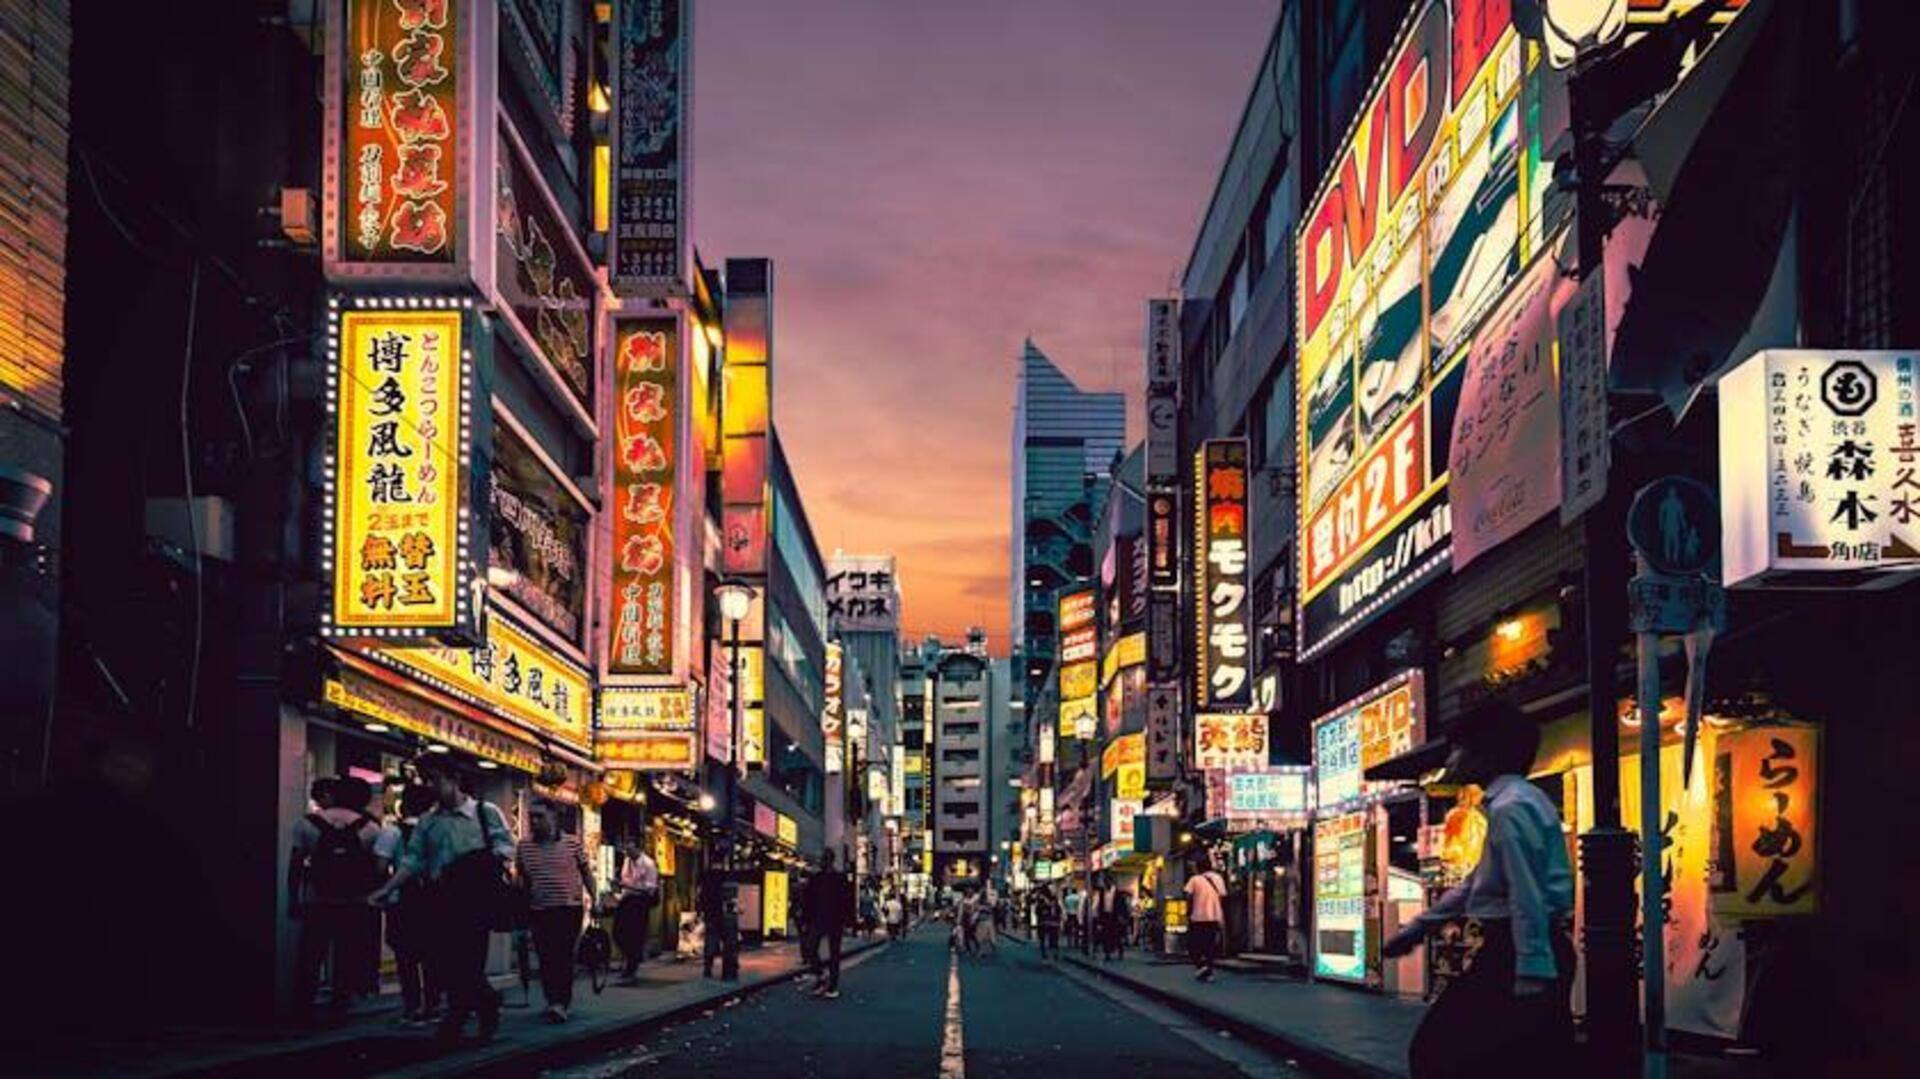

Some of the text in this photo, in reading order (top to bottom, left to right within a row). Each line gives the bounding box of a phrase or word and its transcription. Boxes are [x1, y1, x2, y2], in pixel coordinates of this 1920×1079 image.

[366, 331, 413, 504] 博多風龍
[417, 333, 439, 504] とんこつらーめん
[1824, 440, 1880, 531] 森本
[1832, 420, 1867, 437] 渋谷
[1747, 737, 1812, 905] らーめん
